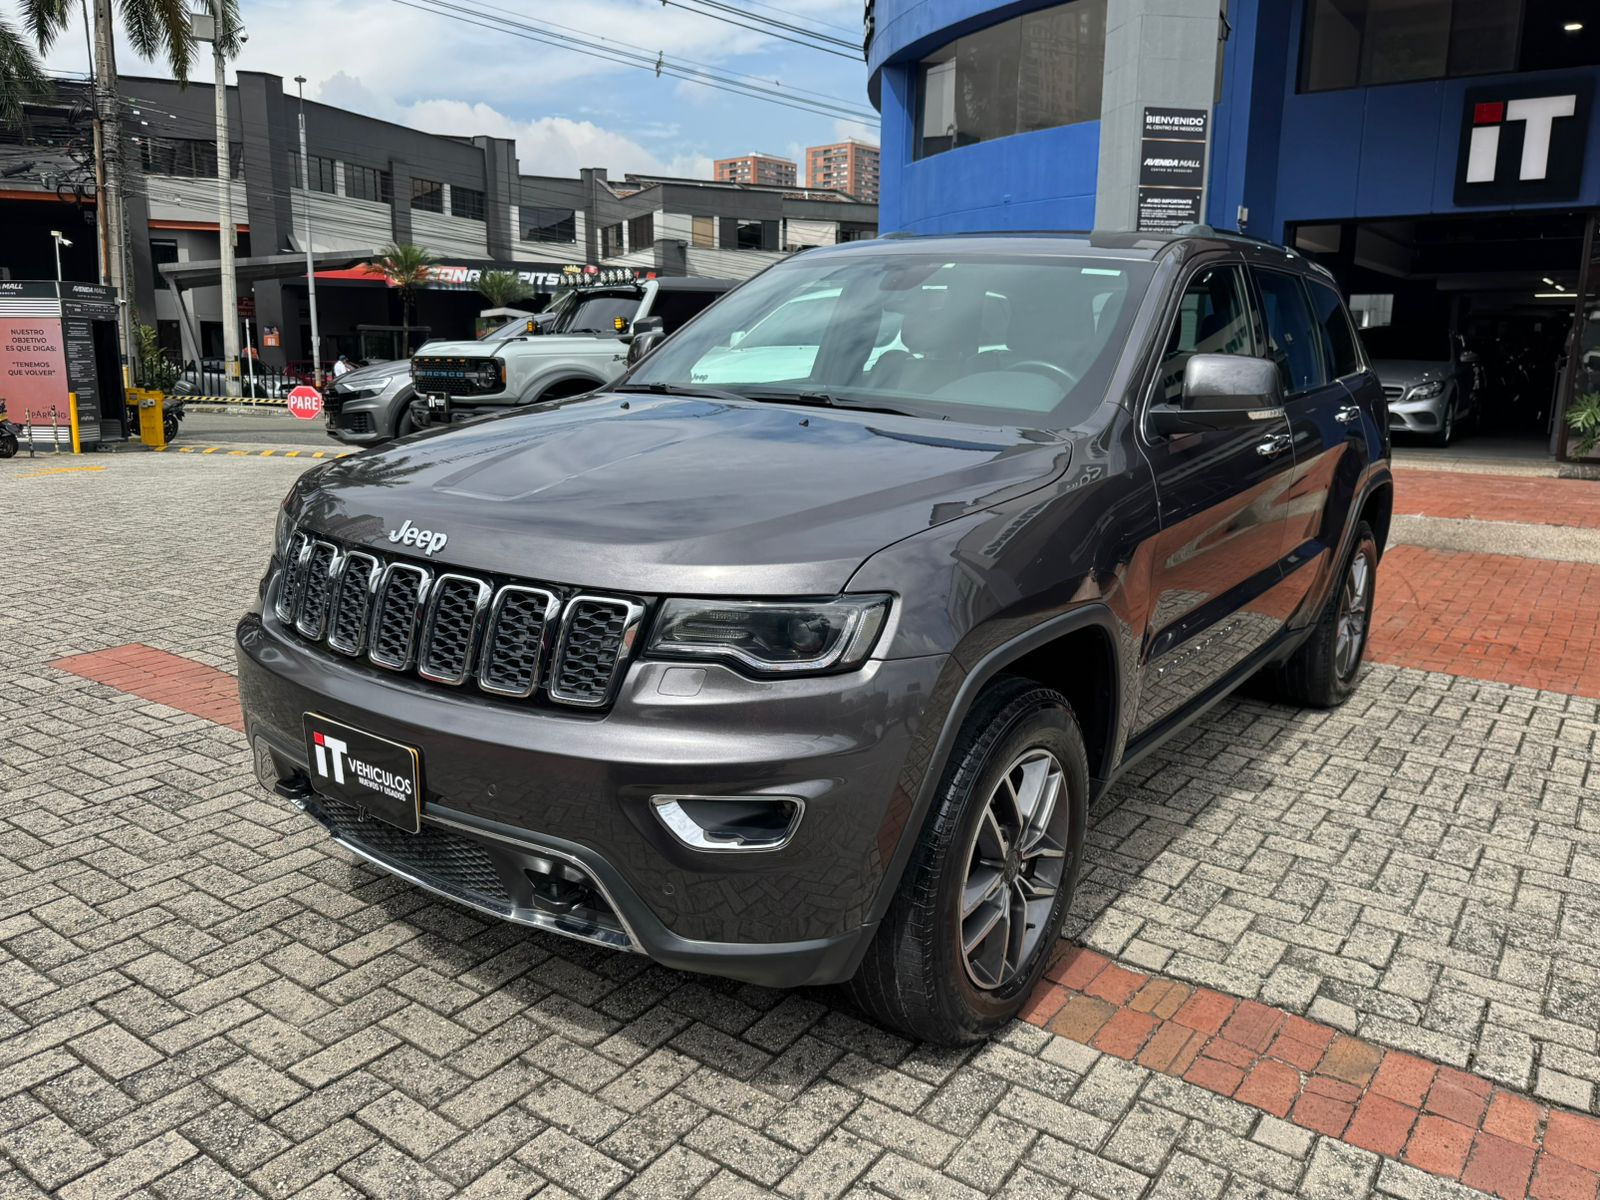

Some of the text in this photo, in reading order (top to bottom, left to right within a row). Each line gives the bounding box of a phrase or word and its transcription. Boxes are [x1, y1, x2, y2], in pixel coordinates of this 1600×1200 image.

[1146, 115, 1204, 126] BIENVENIDO
[1143, 158, 1200, 168] AVENIDA MALL
[691, 373, 709, 382] Jeep
[290, 395, 319, 411] PARE
[388, 519, 448, 557] Jeep
[347, 756, 412, 795] VEHICULOS
